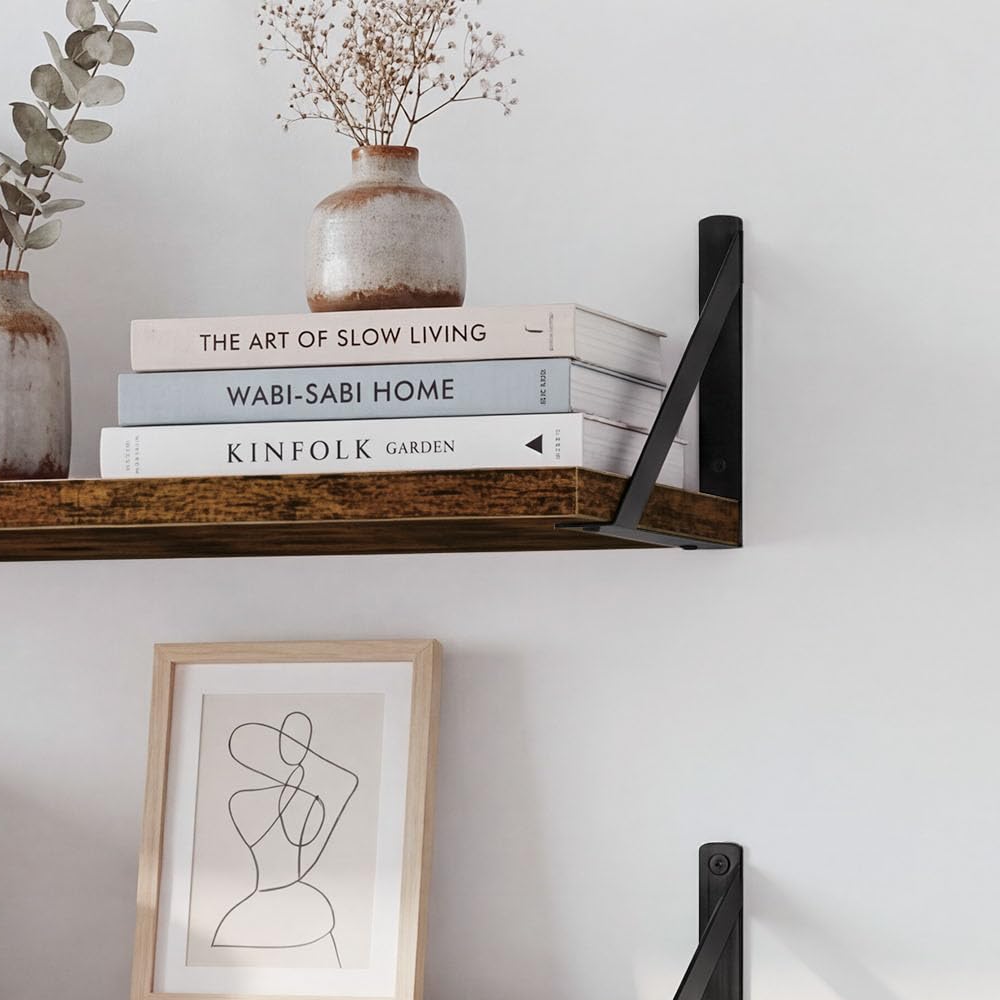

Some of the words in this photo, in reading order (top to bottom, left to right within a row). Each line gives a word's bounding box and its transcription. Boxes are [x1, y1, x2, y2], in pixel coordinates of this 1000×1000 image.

[200, 333, 241, 352] THE
[249, 330, 289, 350] ART
[298, 329, 328, 349] OF
[337, 327, 402, 347] SLOW
[411, 323, 487, 345] LIVING
[227, 380, 362, 406] WABI-SABI
[374, 379, 454, 402] HOME
[227, 439, 371, 464] KINFOLK
[386, 439, 455, 455] GARDEN
